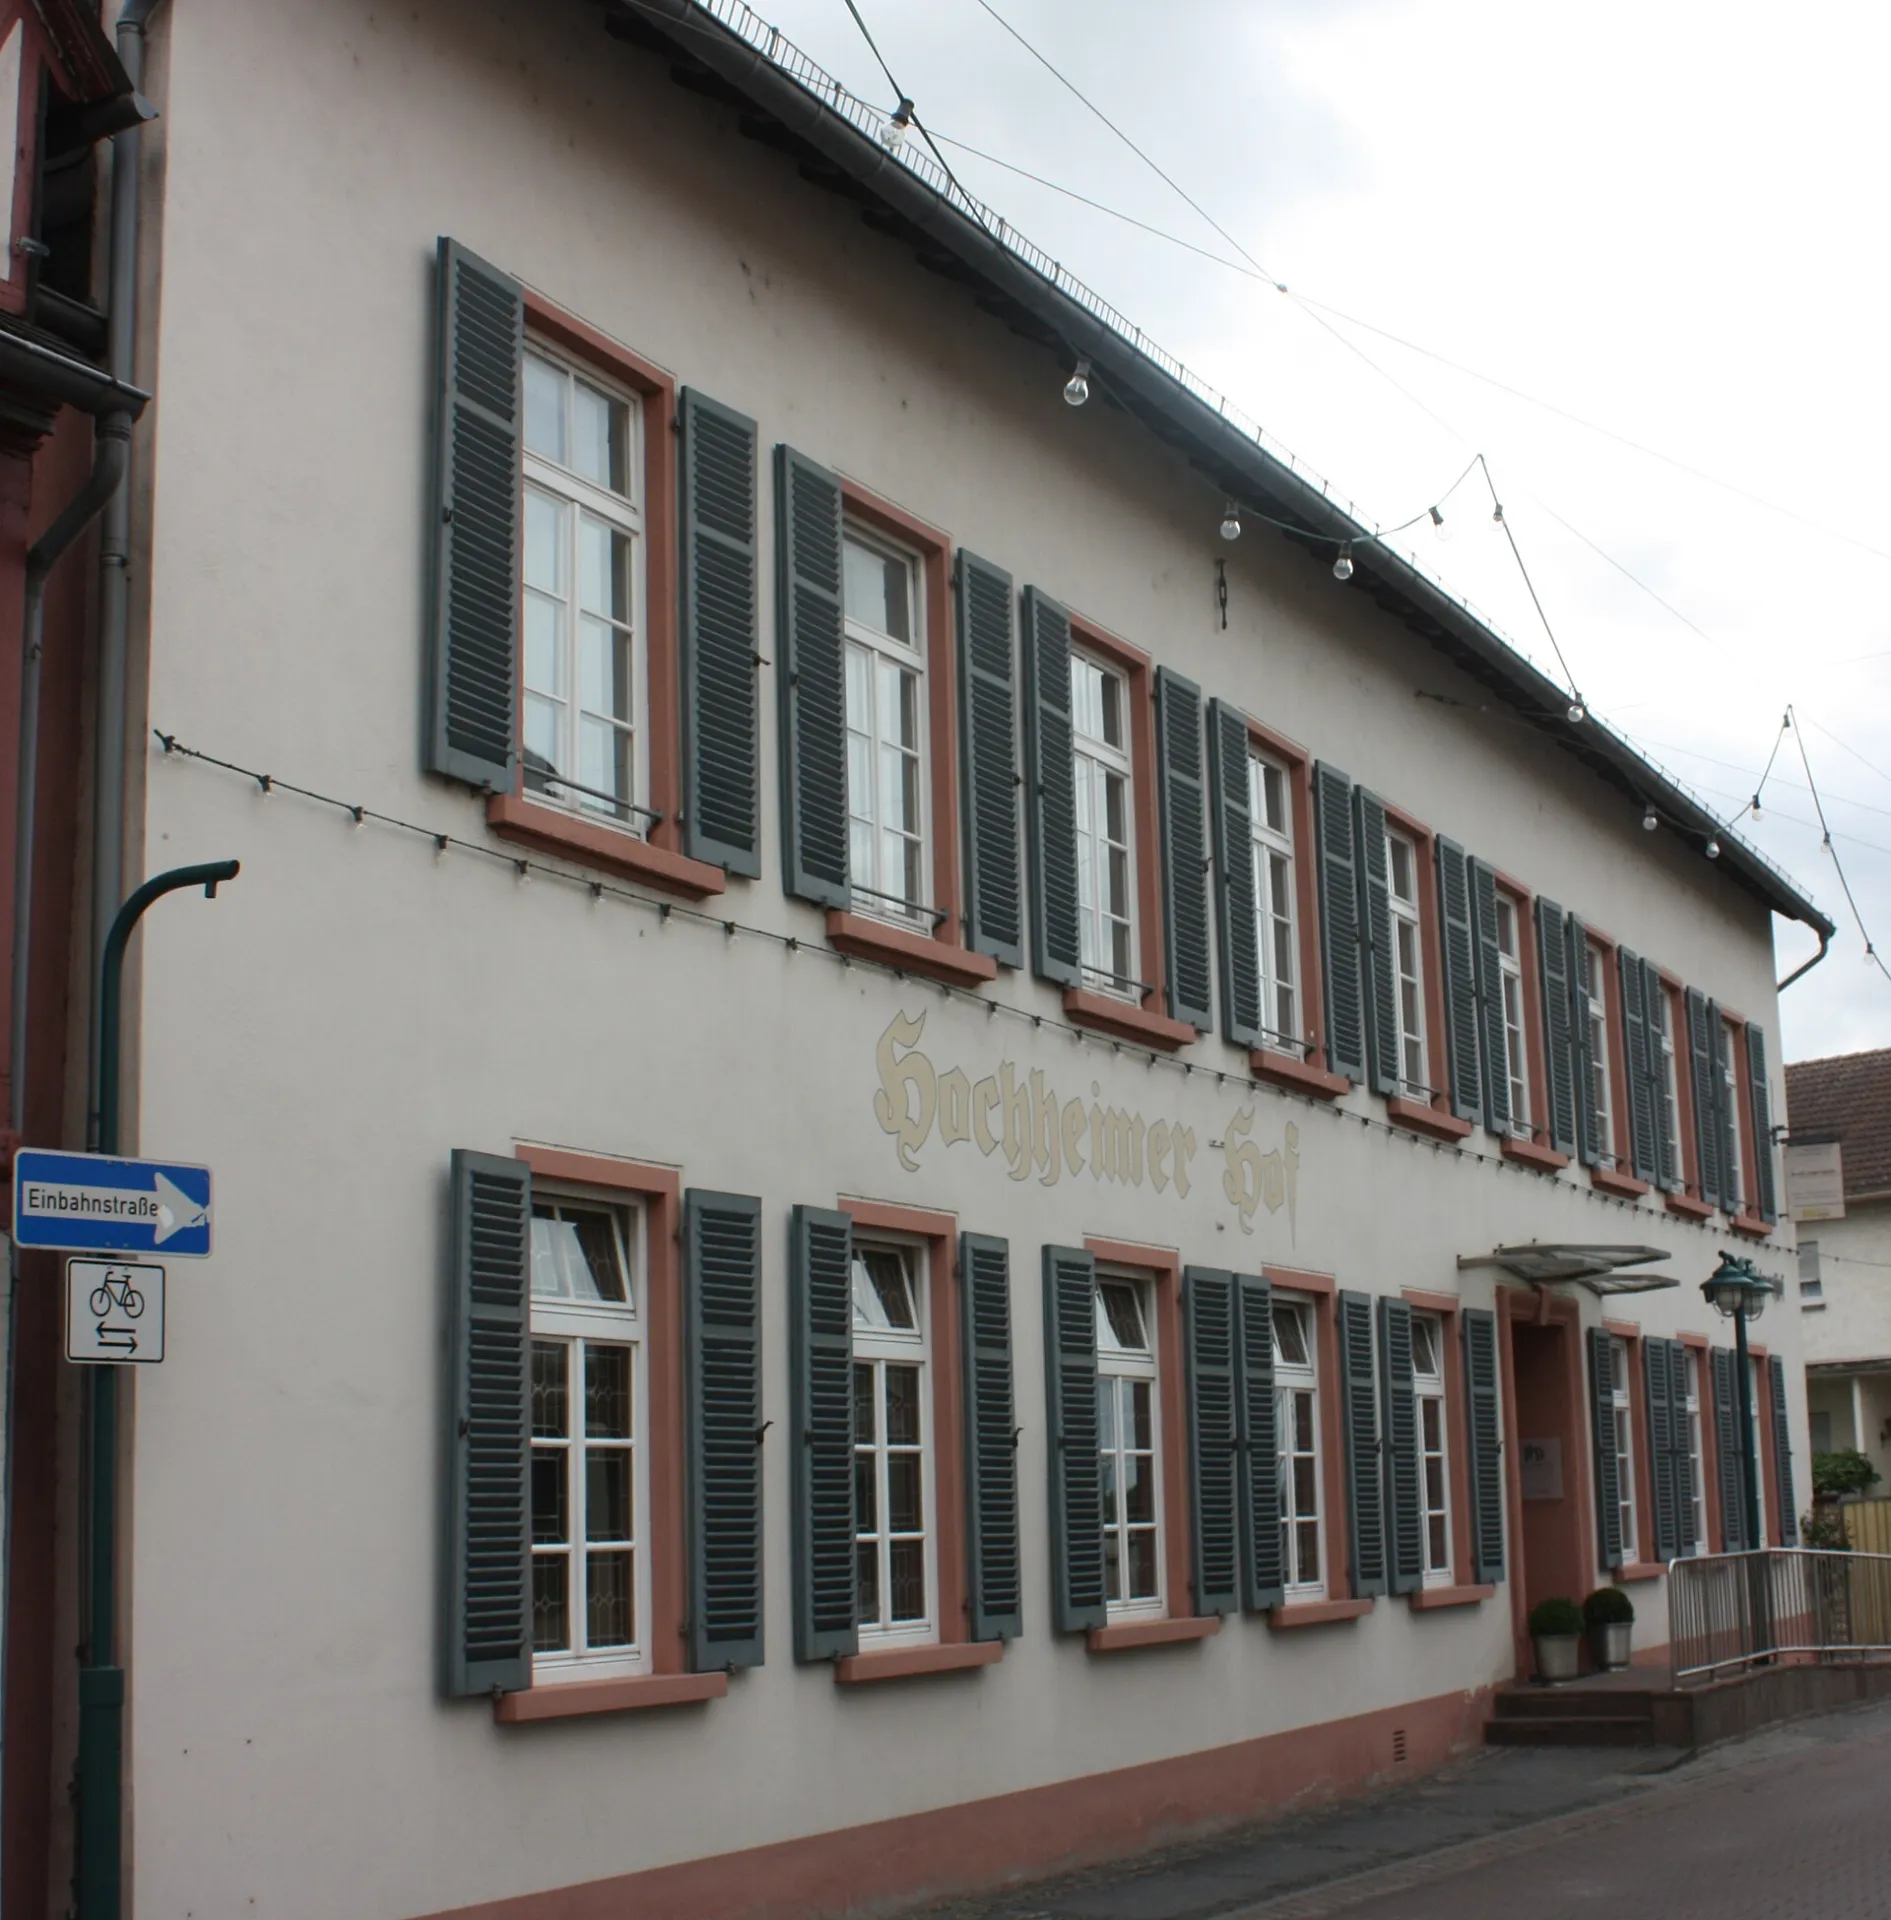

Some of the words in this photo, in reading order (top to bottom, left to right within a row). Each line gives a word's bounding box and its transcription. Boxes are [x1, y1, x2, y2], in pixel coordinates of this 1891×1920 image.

[874, 1008, 1198, 1199] Hochheimer
[1223, 1107, 1300, 1250] Hof
[28, 1188, 159, 1216] Einbahnstraße
